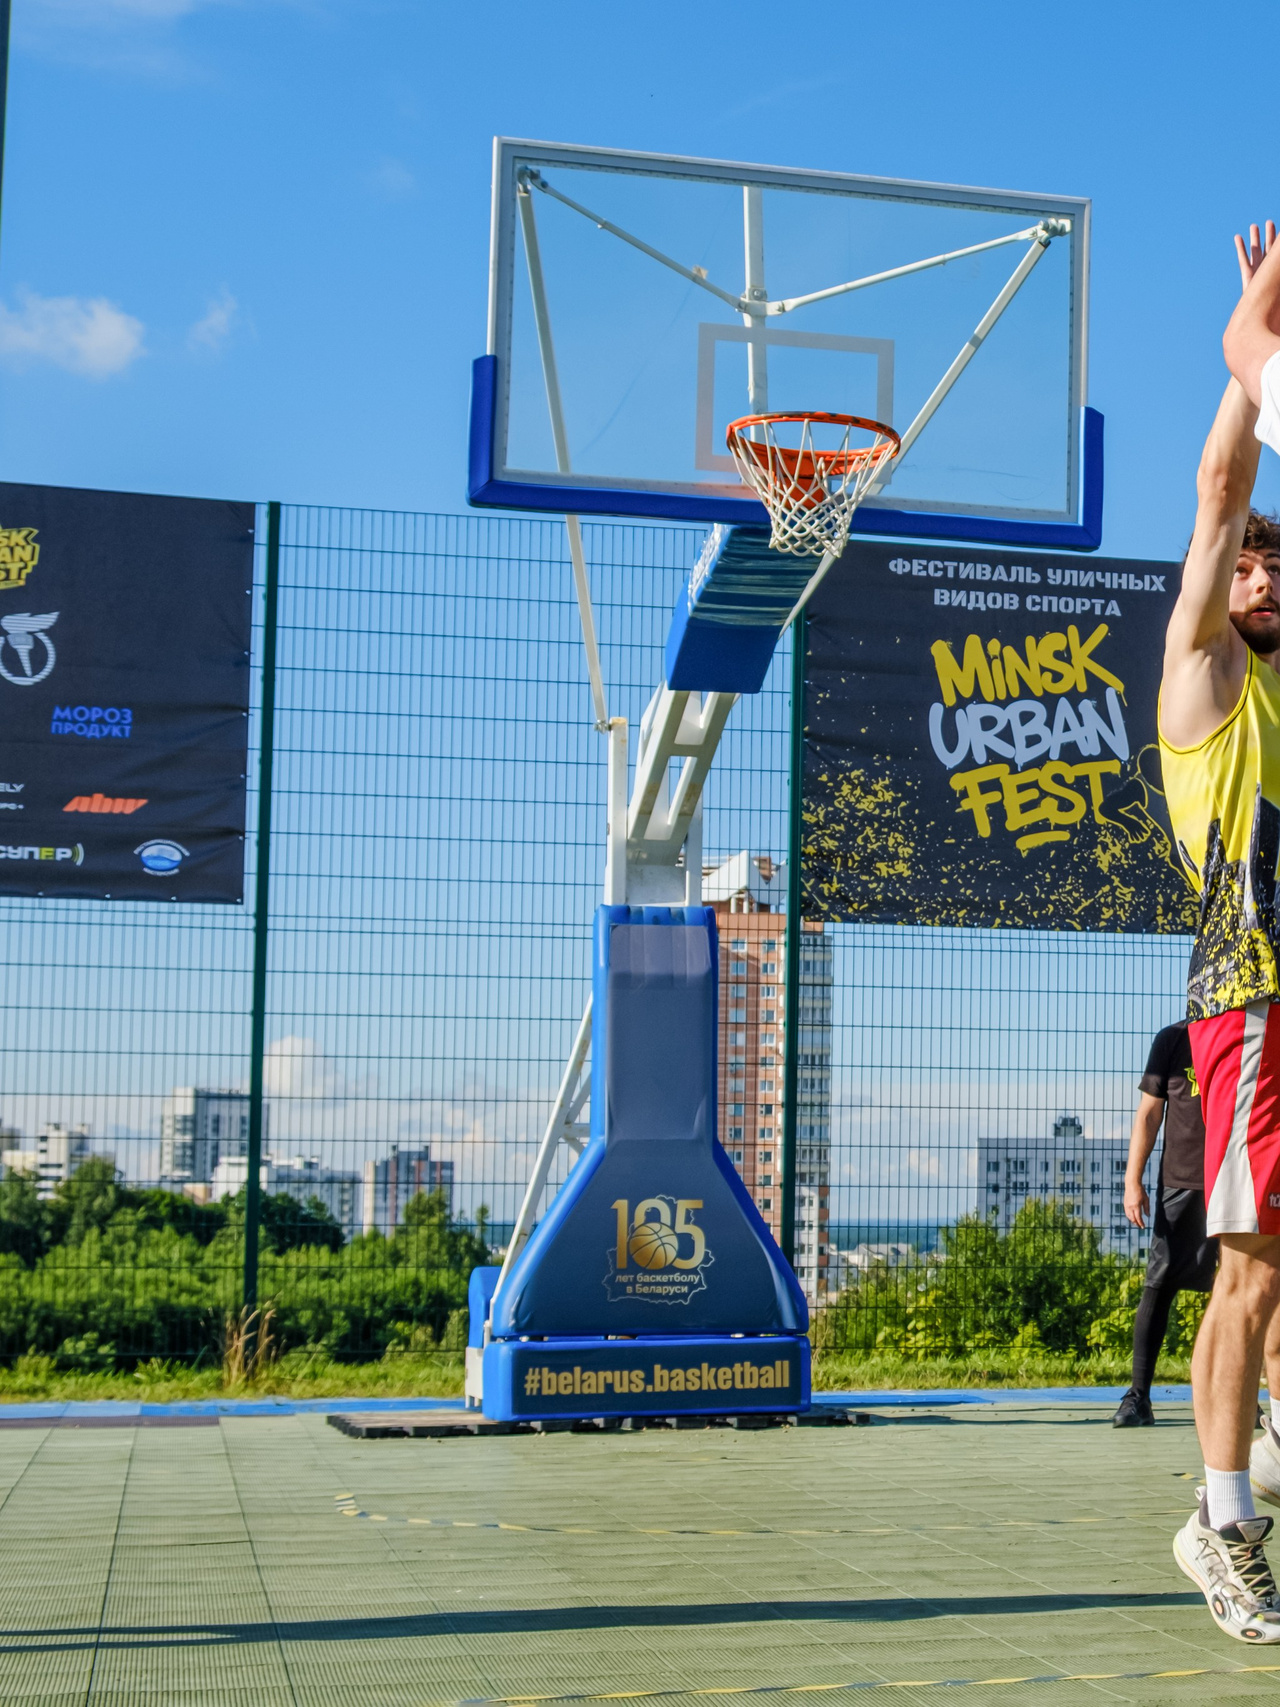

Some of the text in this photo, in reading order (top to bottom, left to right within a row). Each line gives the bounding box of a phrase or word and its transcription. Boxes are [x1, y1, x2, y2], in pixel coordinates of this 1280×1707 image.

[888, 557, 1166, 592] ФЕСТИВАЛЬ УЛИЧНЫХ
[934, 588, 1122, 617] ВИДОВ СПОРТА
[51, 721, 132, 739] ПРОДУКТ
[52, 705, 133, 724] МОРОЗ
[928, 687, 1130, 769] URBAN
[949, 758, 1121, 838] FEST
[610, 1198, 706, 1270] 105
[615, 1272, 700, 1284] лет баскетболу
[626, 1284, 688, 1295] в Беларуси
[524, 1360, 790, 1396] #belarus.basketball
